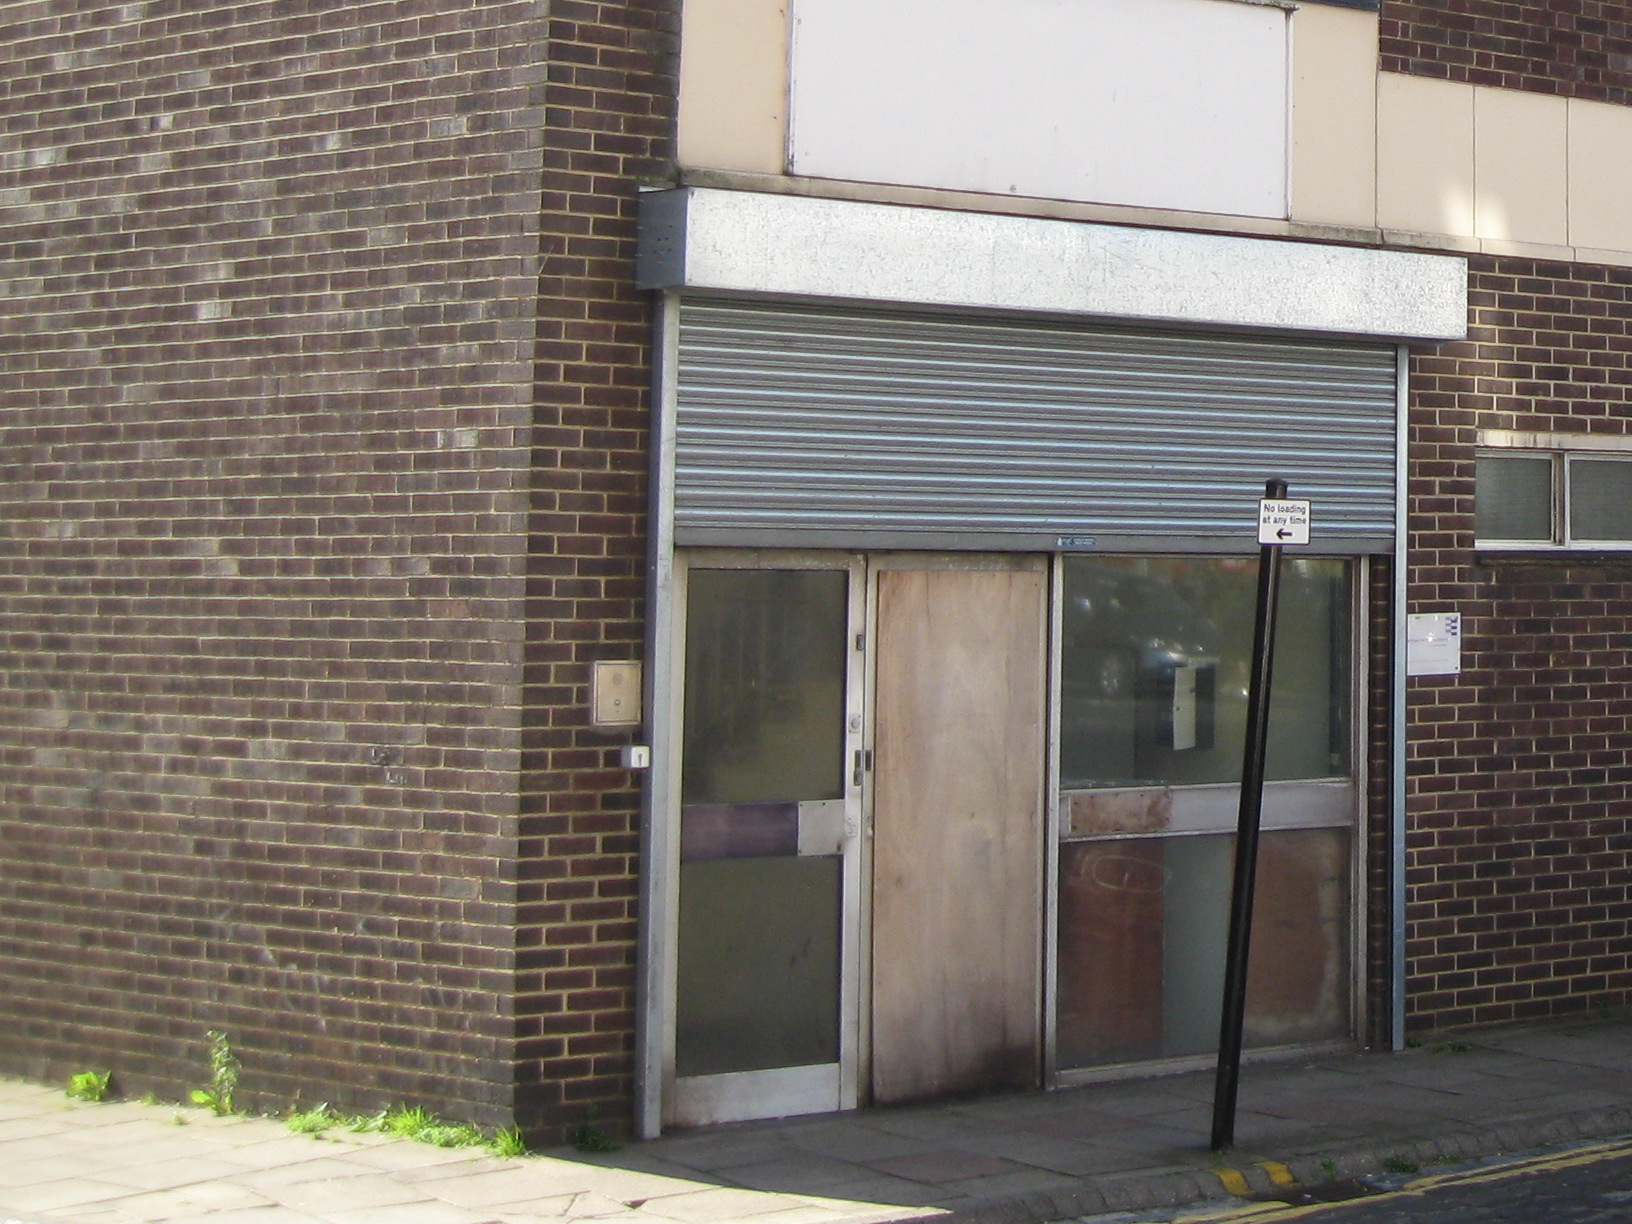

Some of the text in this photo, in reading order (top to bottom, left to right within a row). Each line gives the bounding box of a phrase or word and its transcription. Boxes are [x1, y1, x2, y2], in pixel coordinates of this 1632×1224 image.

[1264, 503, 1306, 516] No loading
[1262, 516, 1306, 526] at any time
